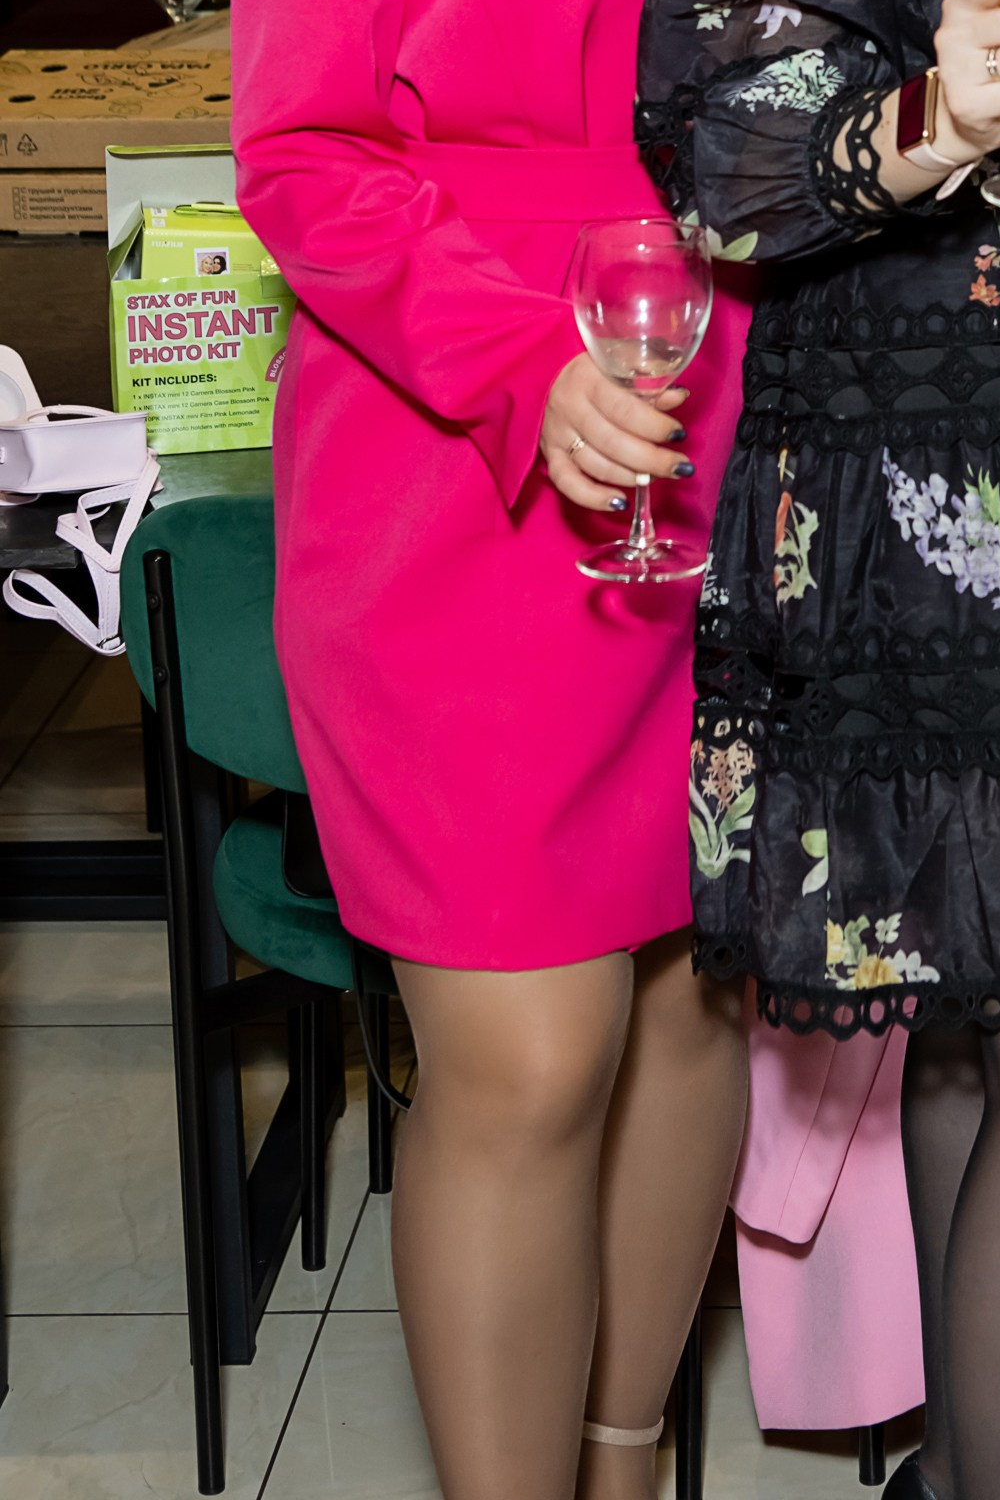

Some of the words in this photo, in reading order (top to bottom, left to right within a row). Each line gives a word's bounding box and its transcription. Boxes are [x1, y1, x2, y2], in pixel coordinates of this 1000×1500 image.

[127, 294, 171, 310] STAX
[174, 292, 198, 307] OF
[201, 290, 236, 305] FUN
[127, 306, 279, 342] INSTANT
[129, 344, 203, 365] PHOTO
[207, 342, 241, 360] KIT
[269, 351, 287, 378] BLOSSO
[132, 378, 151, 387] KIT
[155, 373, 217, 386] INCLUDES:
[143, 392, 166, 400] INSTAX
[215, 387, 241, 395] Blossom
[228, 408, 260, 416] Lemonade
[171, 425, 189, 433] photo
[190, 423, 213, 431] holders
[227, 420, 254, 428] magnets
